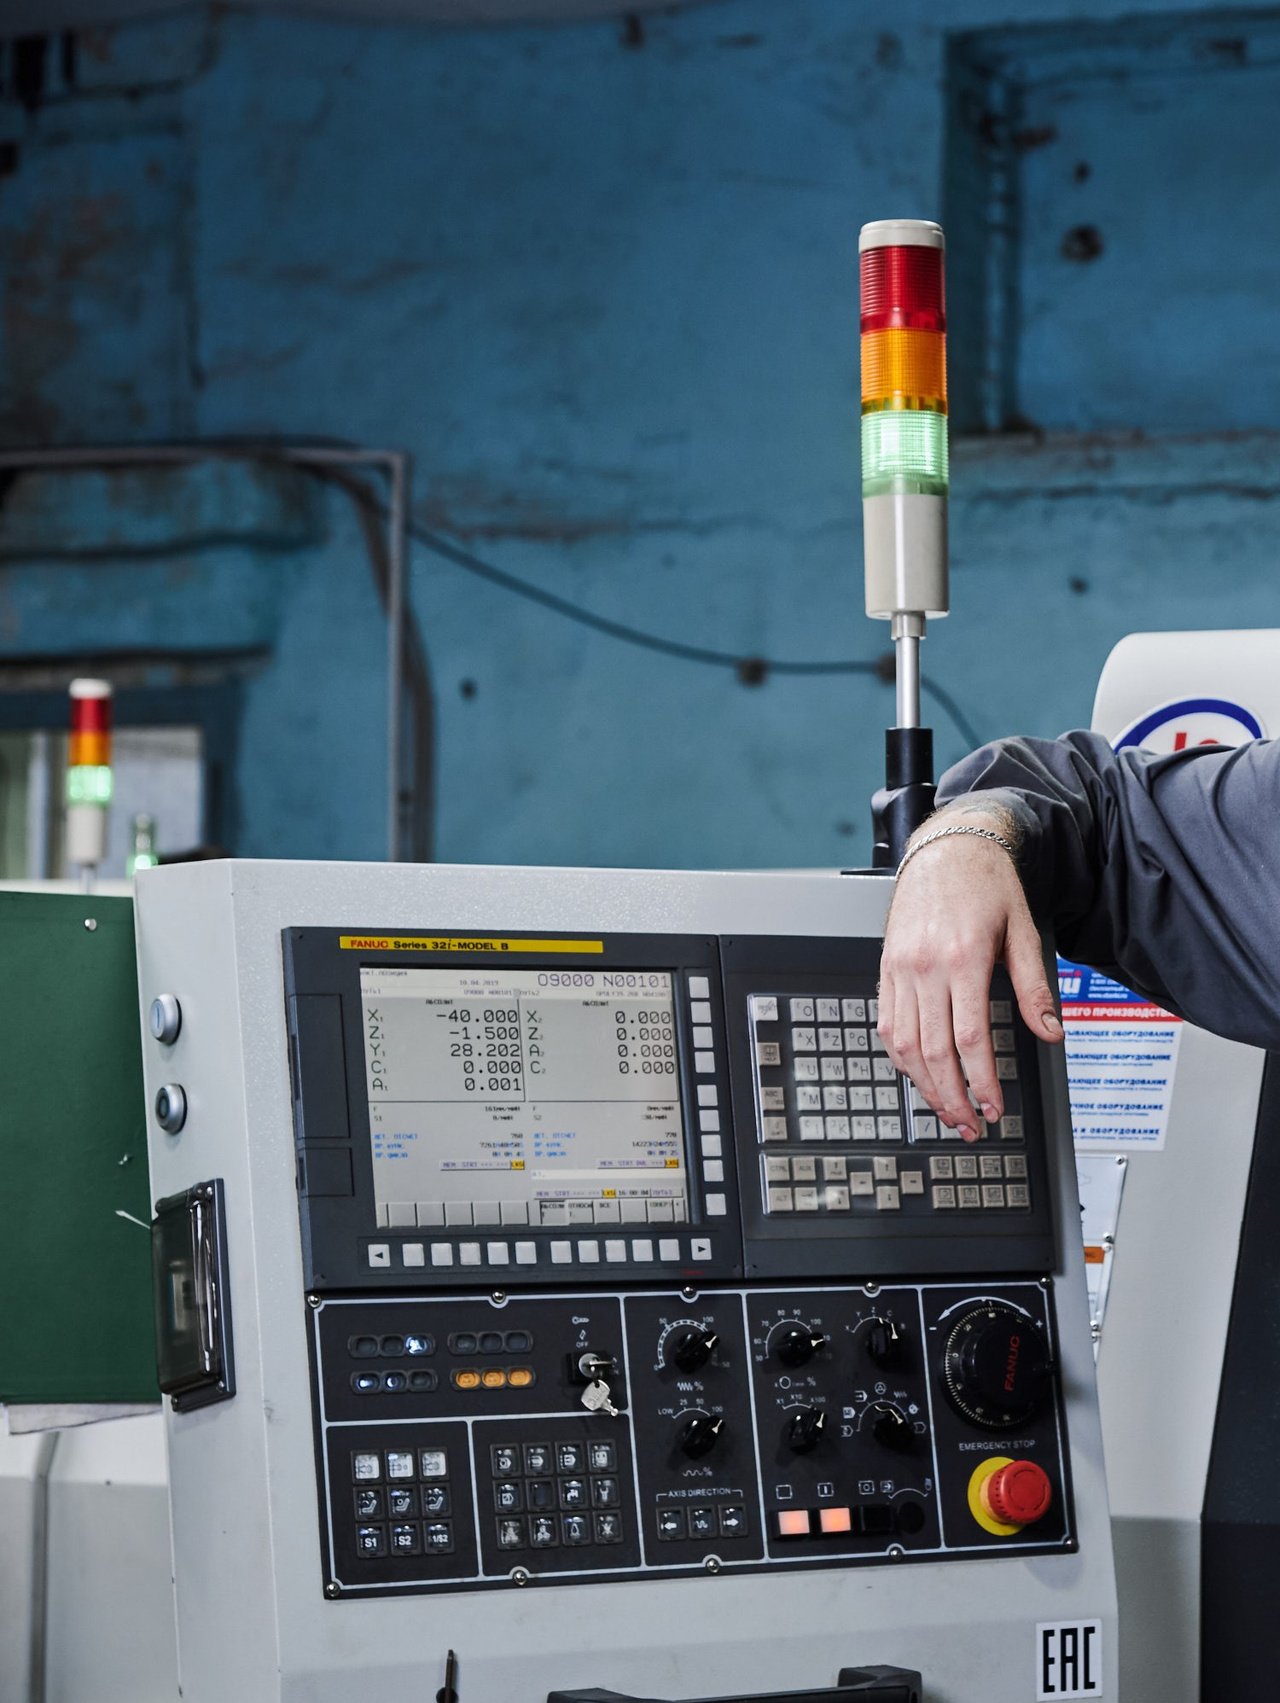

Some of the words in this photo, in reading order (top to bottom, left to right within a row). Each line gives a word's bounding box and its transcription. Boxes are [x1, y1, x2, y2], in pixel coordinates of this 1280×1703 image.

[350, 940, 389, 948] FANUC
[393, 941, 428, 949] Series
[501, 942, 509, 950] B
[602, 974, 670, 988] N00101
[436, 1009, 518, 1023] -40.000
[615, 1010, 672, 1024] 0.000
[829, 1006, 838, 1017] N
[855, 1006, 865, 1017] G
[1062, 1007, 1091, 1017] ШЕГО
[1092, 1007, 1175, 1019] ПРОИЗВОДСТВ
[449, 1026, 520, 1040] -1.500
[616, 1027, 673, 1041] 0.000
[806, 1035, 814, 1046] X
[832, 1035, 841, 1046] Z
[857, 1035, 867, 1047] C
[450, 1043, 521, 1057] 28.202
[617, 1044, 674, 1058] 0.000
[463, 1060, 522, 1074] 0.000
[618, 1060, 676, 1075] 0.000
[807, 1064, 816, 1076] U
[833, 1065, 843, 1076] W
[861, 1065, 869, 1076] H
[885, 1065, 894, 1076] V
[464, 1077, 522, 1091] 0.001
[809, 1094, 819, 1105] M
[836, 1093, 845, 1105] S
[862, 1094, 871, 1105] T
[888, 1094, 897, 1105] L
[838, 1123, 848, 1134] K
[864, 1123, 874, 1134] R
[891, 1123, 899, 1134] F
[1004, 1335, 1021, 1392] FANUC
[680, 1398, 688, 1406] 25
[711, 1405, 723, 1413] 100
[958, 1442, 1011, 1451] EMERGENCY
[1014, 1440, 1036, 1449] STOP
[668, 1490, 687, 1498] AXIS
[687, 1488, 731, 1497] DIRECTION
[364, 1537, 377, 1548] S1
[398, 1535, 412, 1546] S2
[1042, 1626, 1096, 1693] EAC
